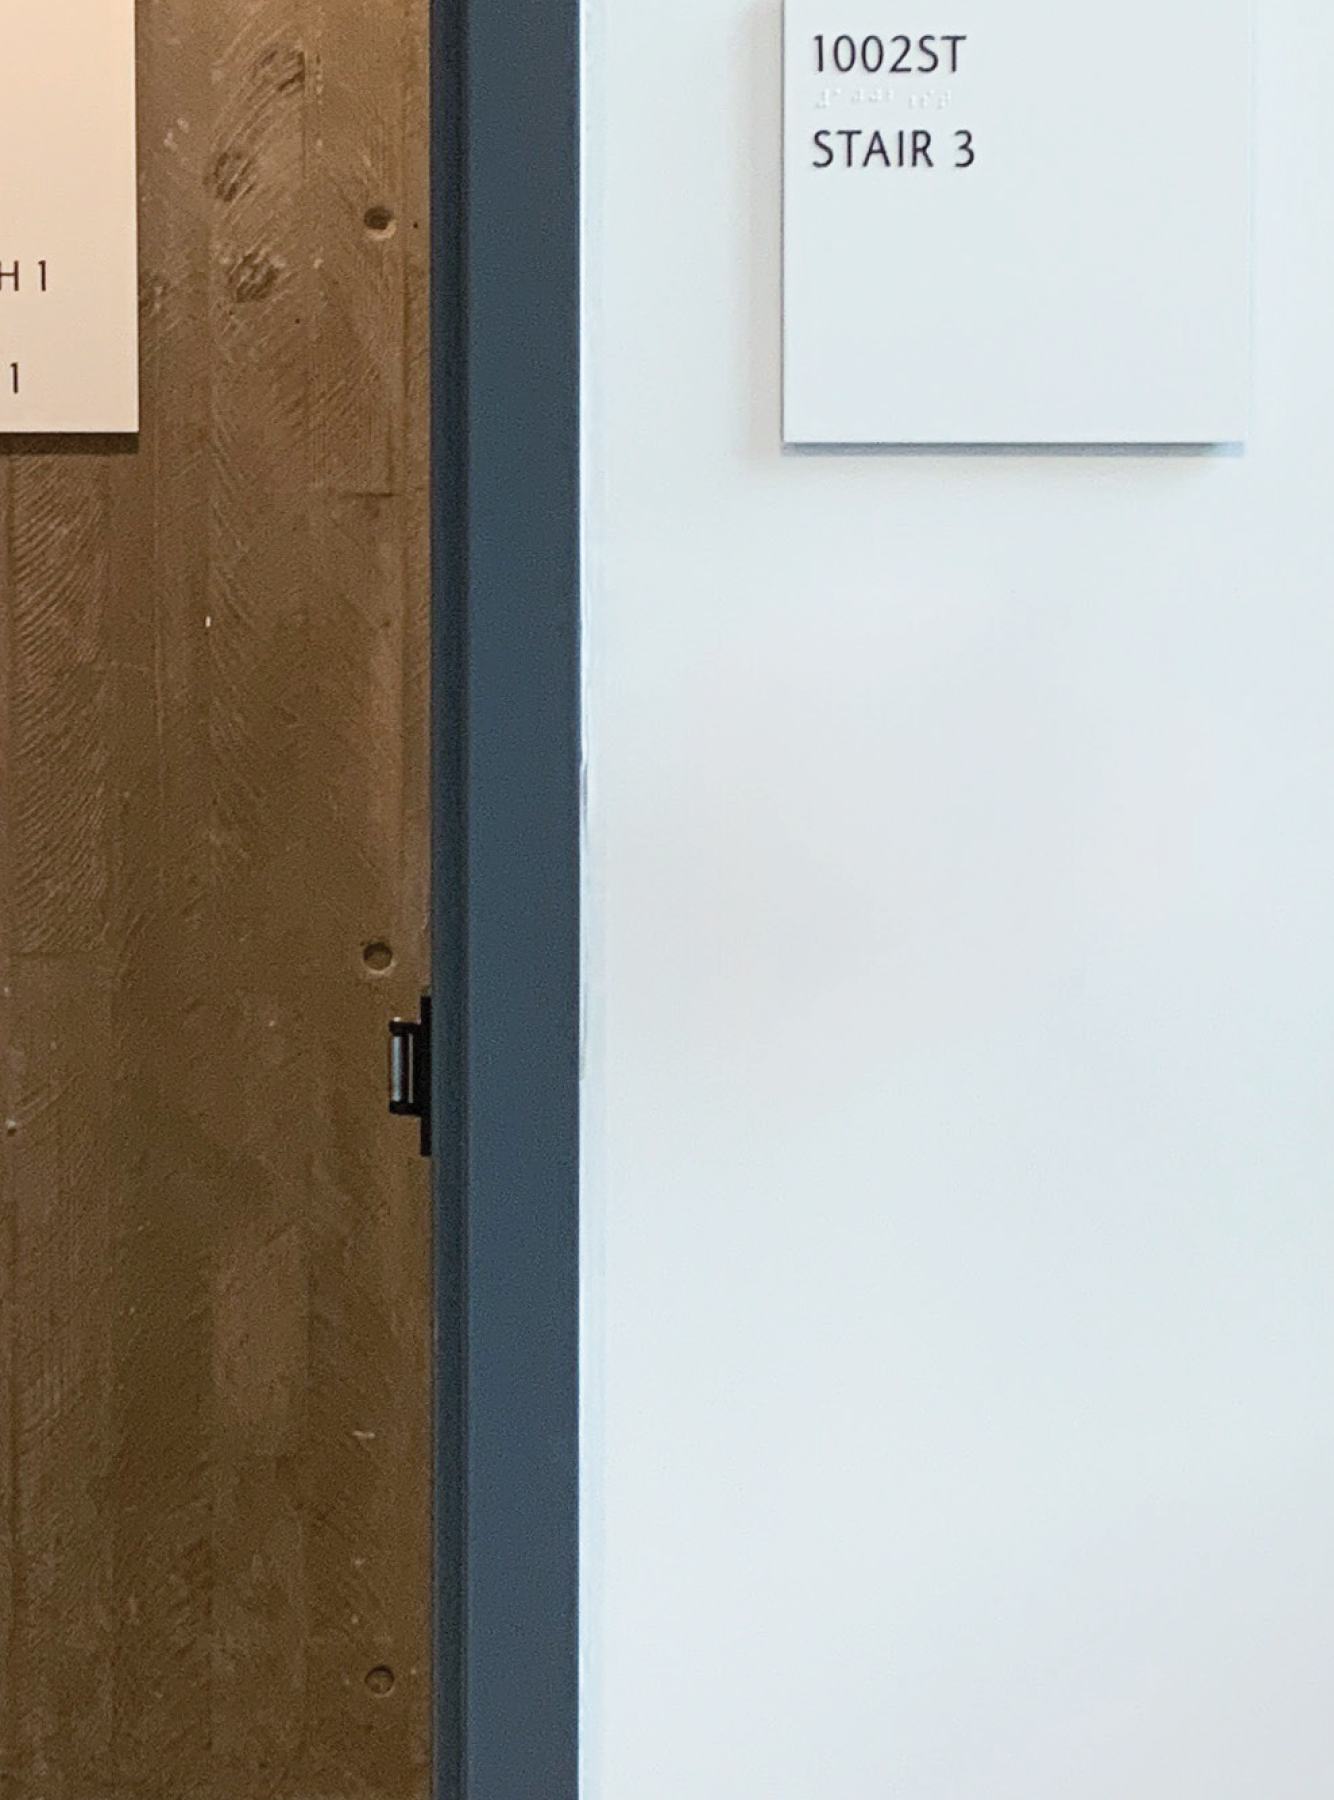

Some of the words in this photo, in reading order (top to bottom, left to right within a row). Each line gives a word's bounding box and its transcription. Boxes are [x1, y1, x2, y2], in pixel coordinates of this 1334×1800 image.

[813, 34, 967, 74] 1002ST
[812, 129, 934, 169] STAIR
[954, 129, 975, 169] 3
[37, 259, 47, 292] 1
[10, 361, 19, 395] 1
